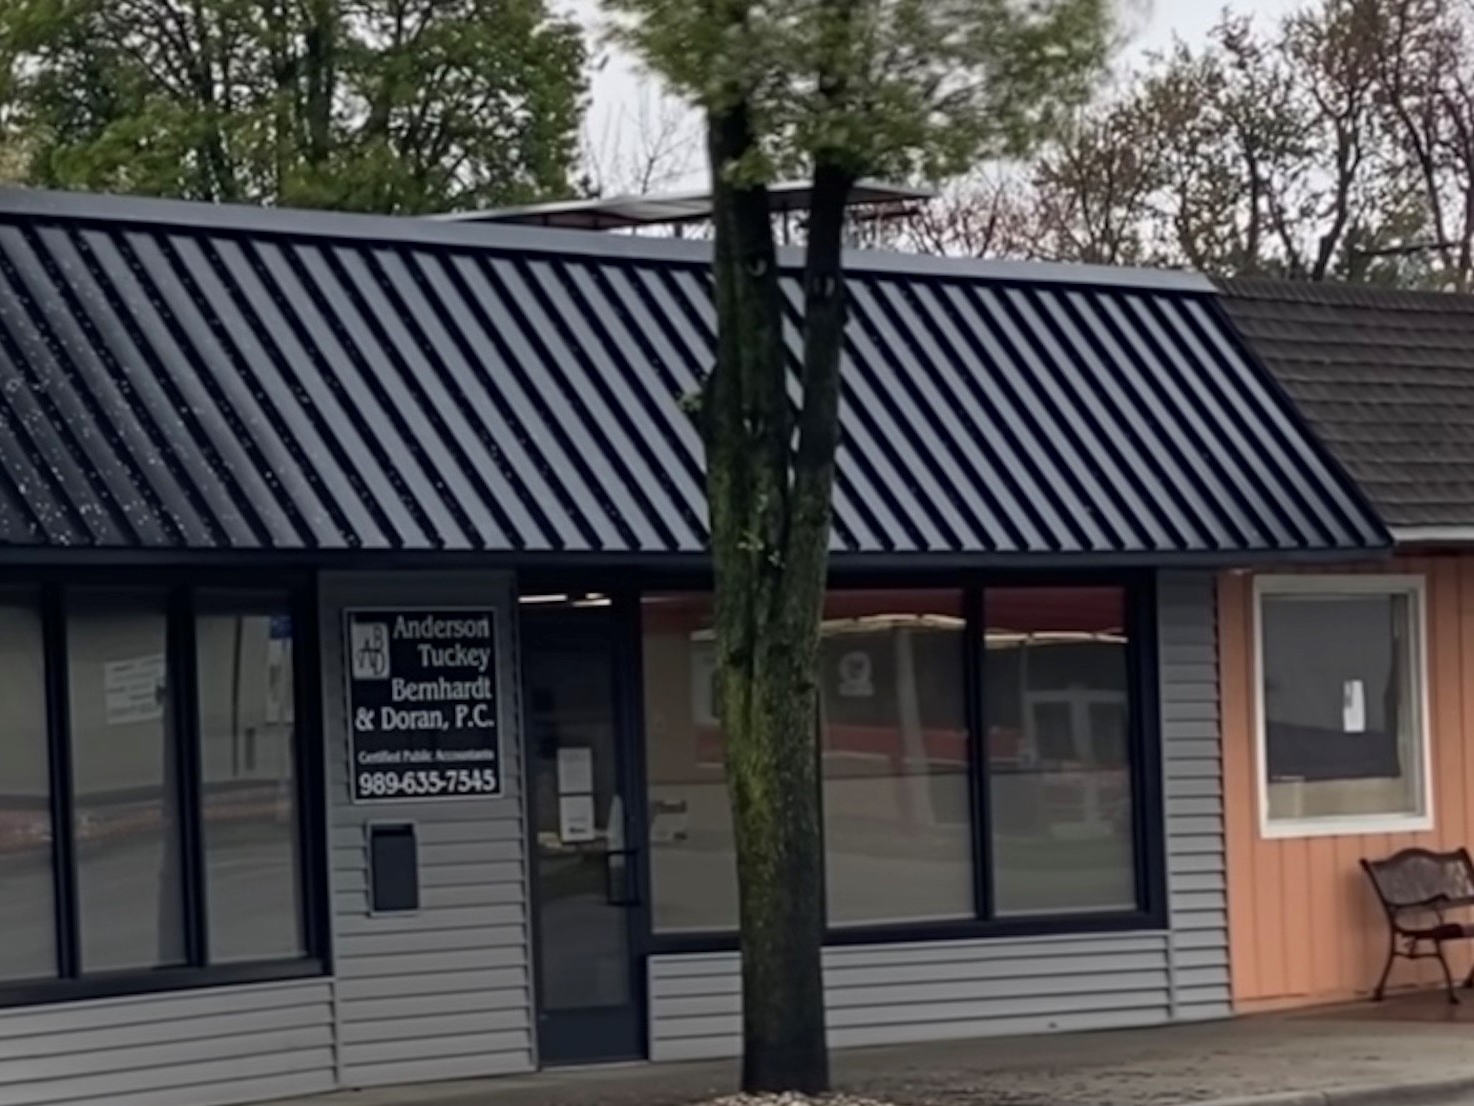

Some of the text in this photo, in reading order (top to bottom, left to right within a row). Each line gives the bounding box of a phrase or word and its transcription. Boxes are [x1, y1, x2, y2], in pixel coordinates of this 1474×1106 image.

[392, 614, 490, 640] Anderson
[416, 643, 491, 673] Tuckey
[391, 676, 493, 702] Bernhardt
[355, 703, 495, 731] & Doran, P.C.
[358, 768, 496, 796] 989-635-7545
